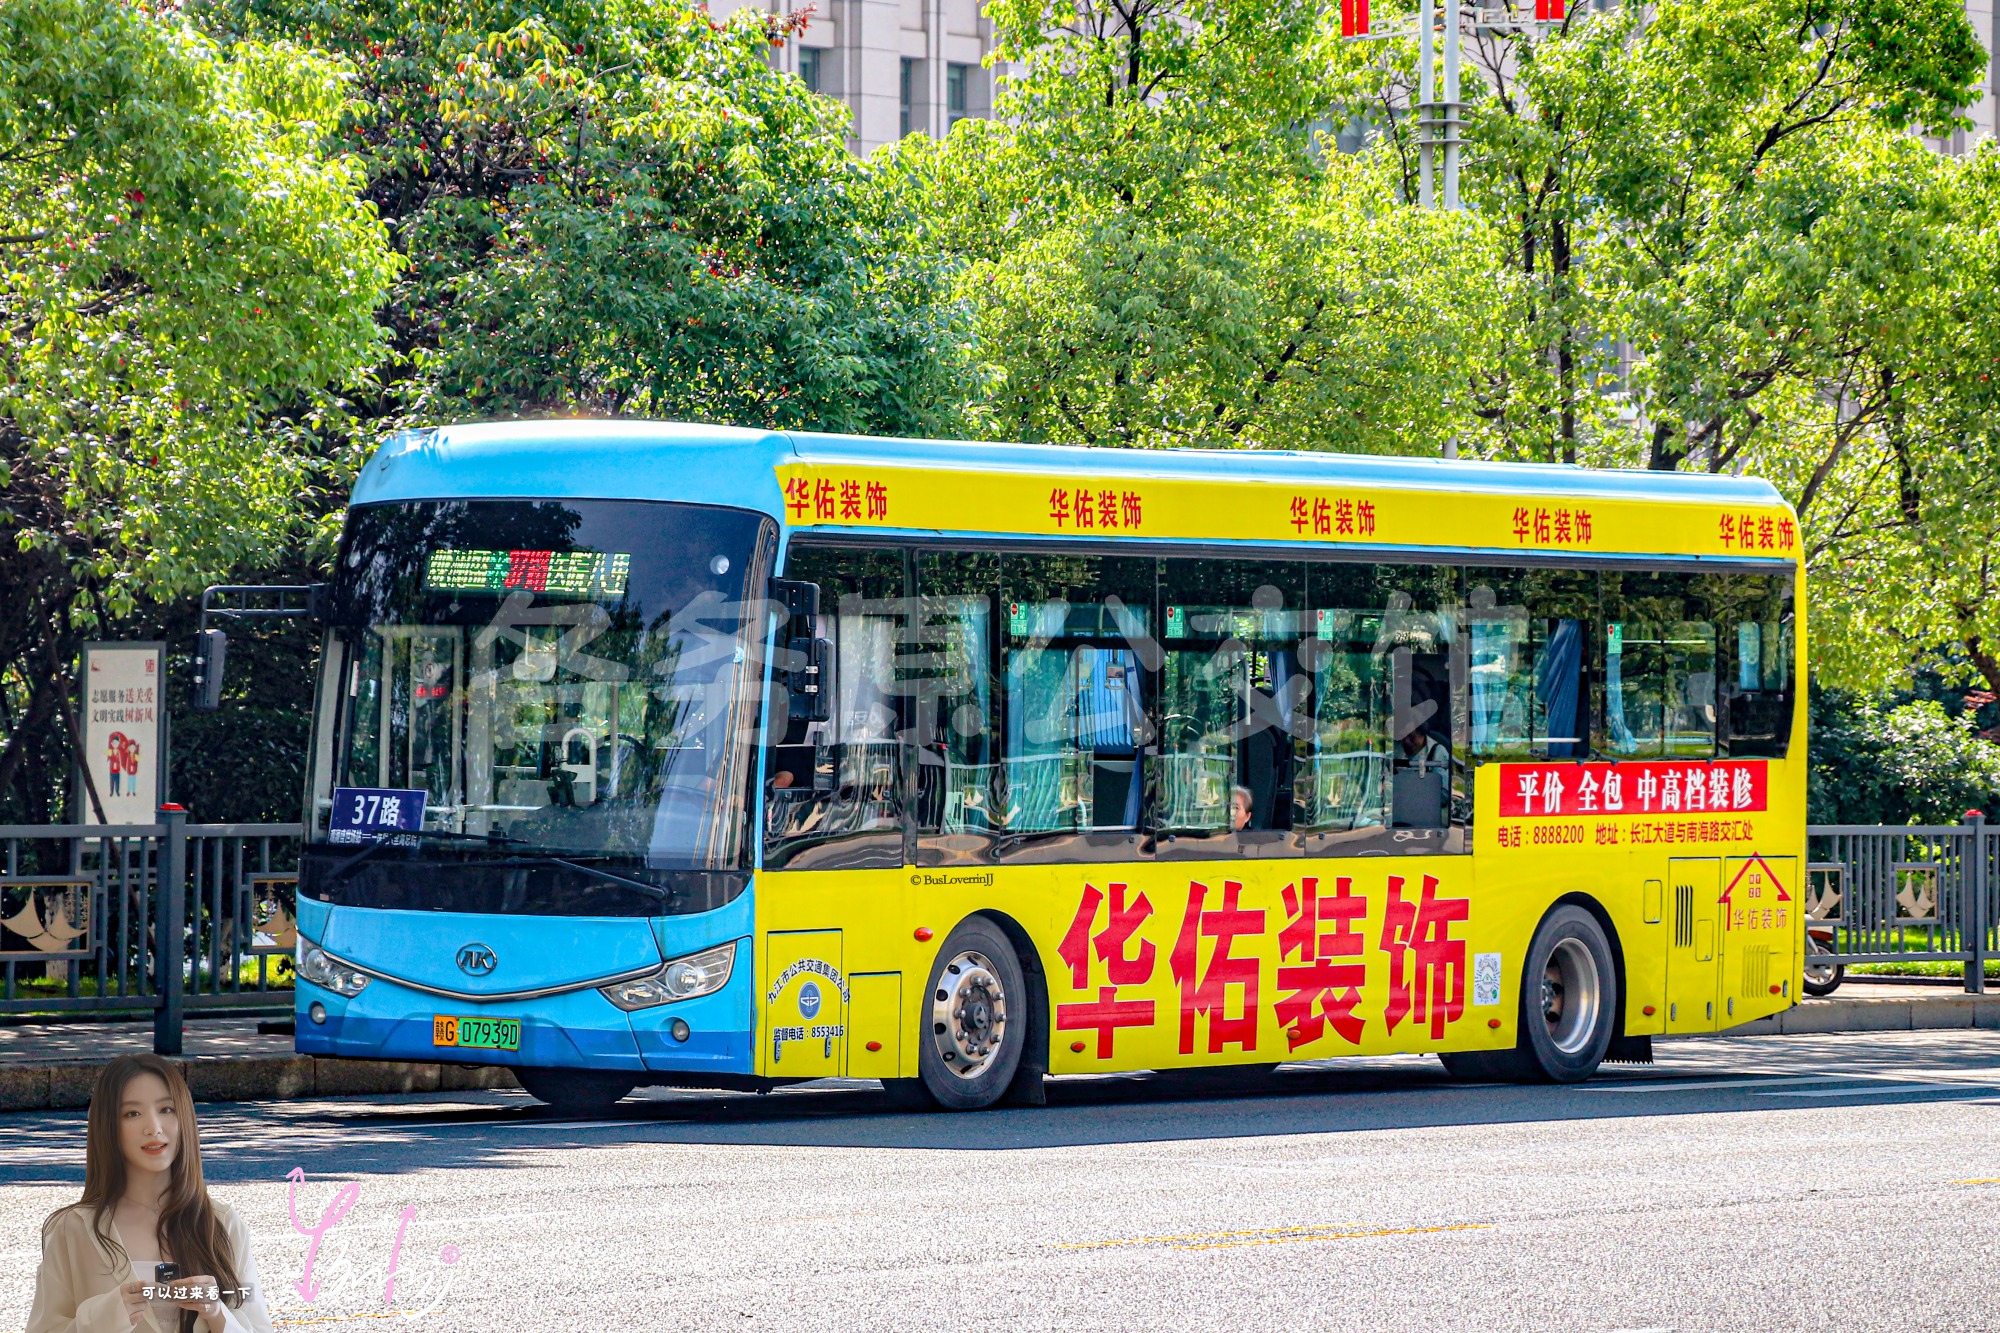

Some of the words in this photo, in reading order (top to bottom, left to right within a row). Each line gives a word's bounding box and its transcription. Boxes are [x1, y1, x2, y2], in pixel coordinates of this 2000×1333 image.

[785, 477, 888, 521] 华佑装饰
[1049, 488, 1142, 529] 华佑装饰
[1290, 496, 1375, 536] 华佑装饰
[1513, 507, 1592, 544] 华佑装饰
[1719, 513, 1794, 551] 华佑装饰
[92, 687, 154, 703] 志愿服务送关爱
[92, 707, 154, 723] 文明实践树新风
[1517, 770, 1565, 814] 平价
[1577, 769, 1624, 811] 全包
[1637, 767, 1753, 811] 中高档装修
[351, 794, 401, 827] 37路
[1733, 907, 1787, 931] 华佑装饰
[767, 958, 850, 1006] 九江市公共交通集团公司
[1056, 874, 1470, 1060] 华佑装饰
